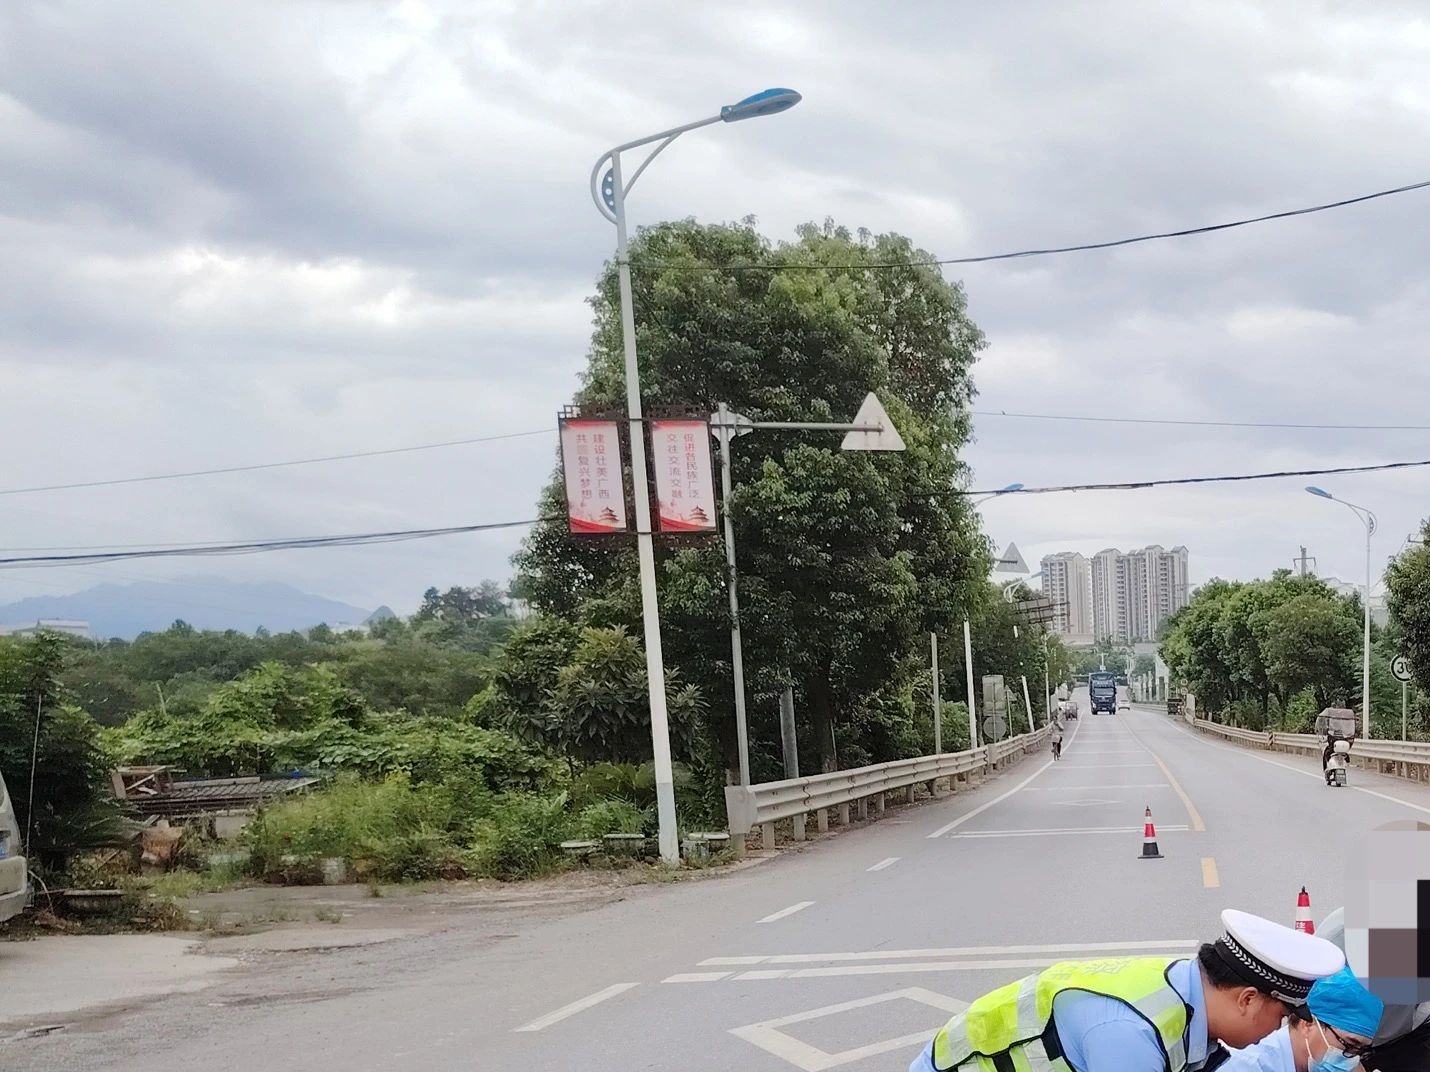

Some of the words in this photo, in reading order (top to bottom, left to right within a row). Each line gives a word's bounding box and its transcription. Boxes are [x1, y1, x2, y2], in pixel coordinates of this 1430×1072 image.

[593, 433, 610, 500] 建设壮美广西
[666, 433, 683, 499] 交往交流交融
